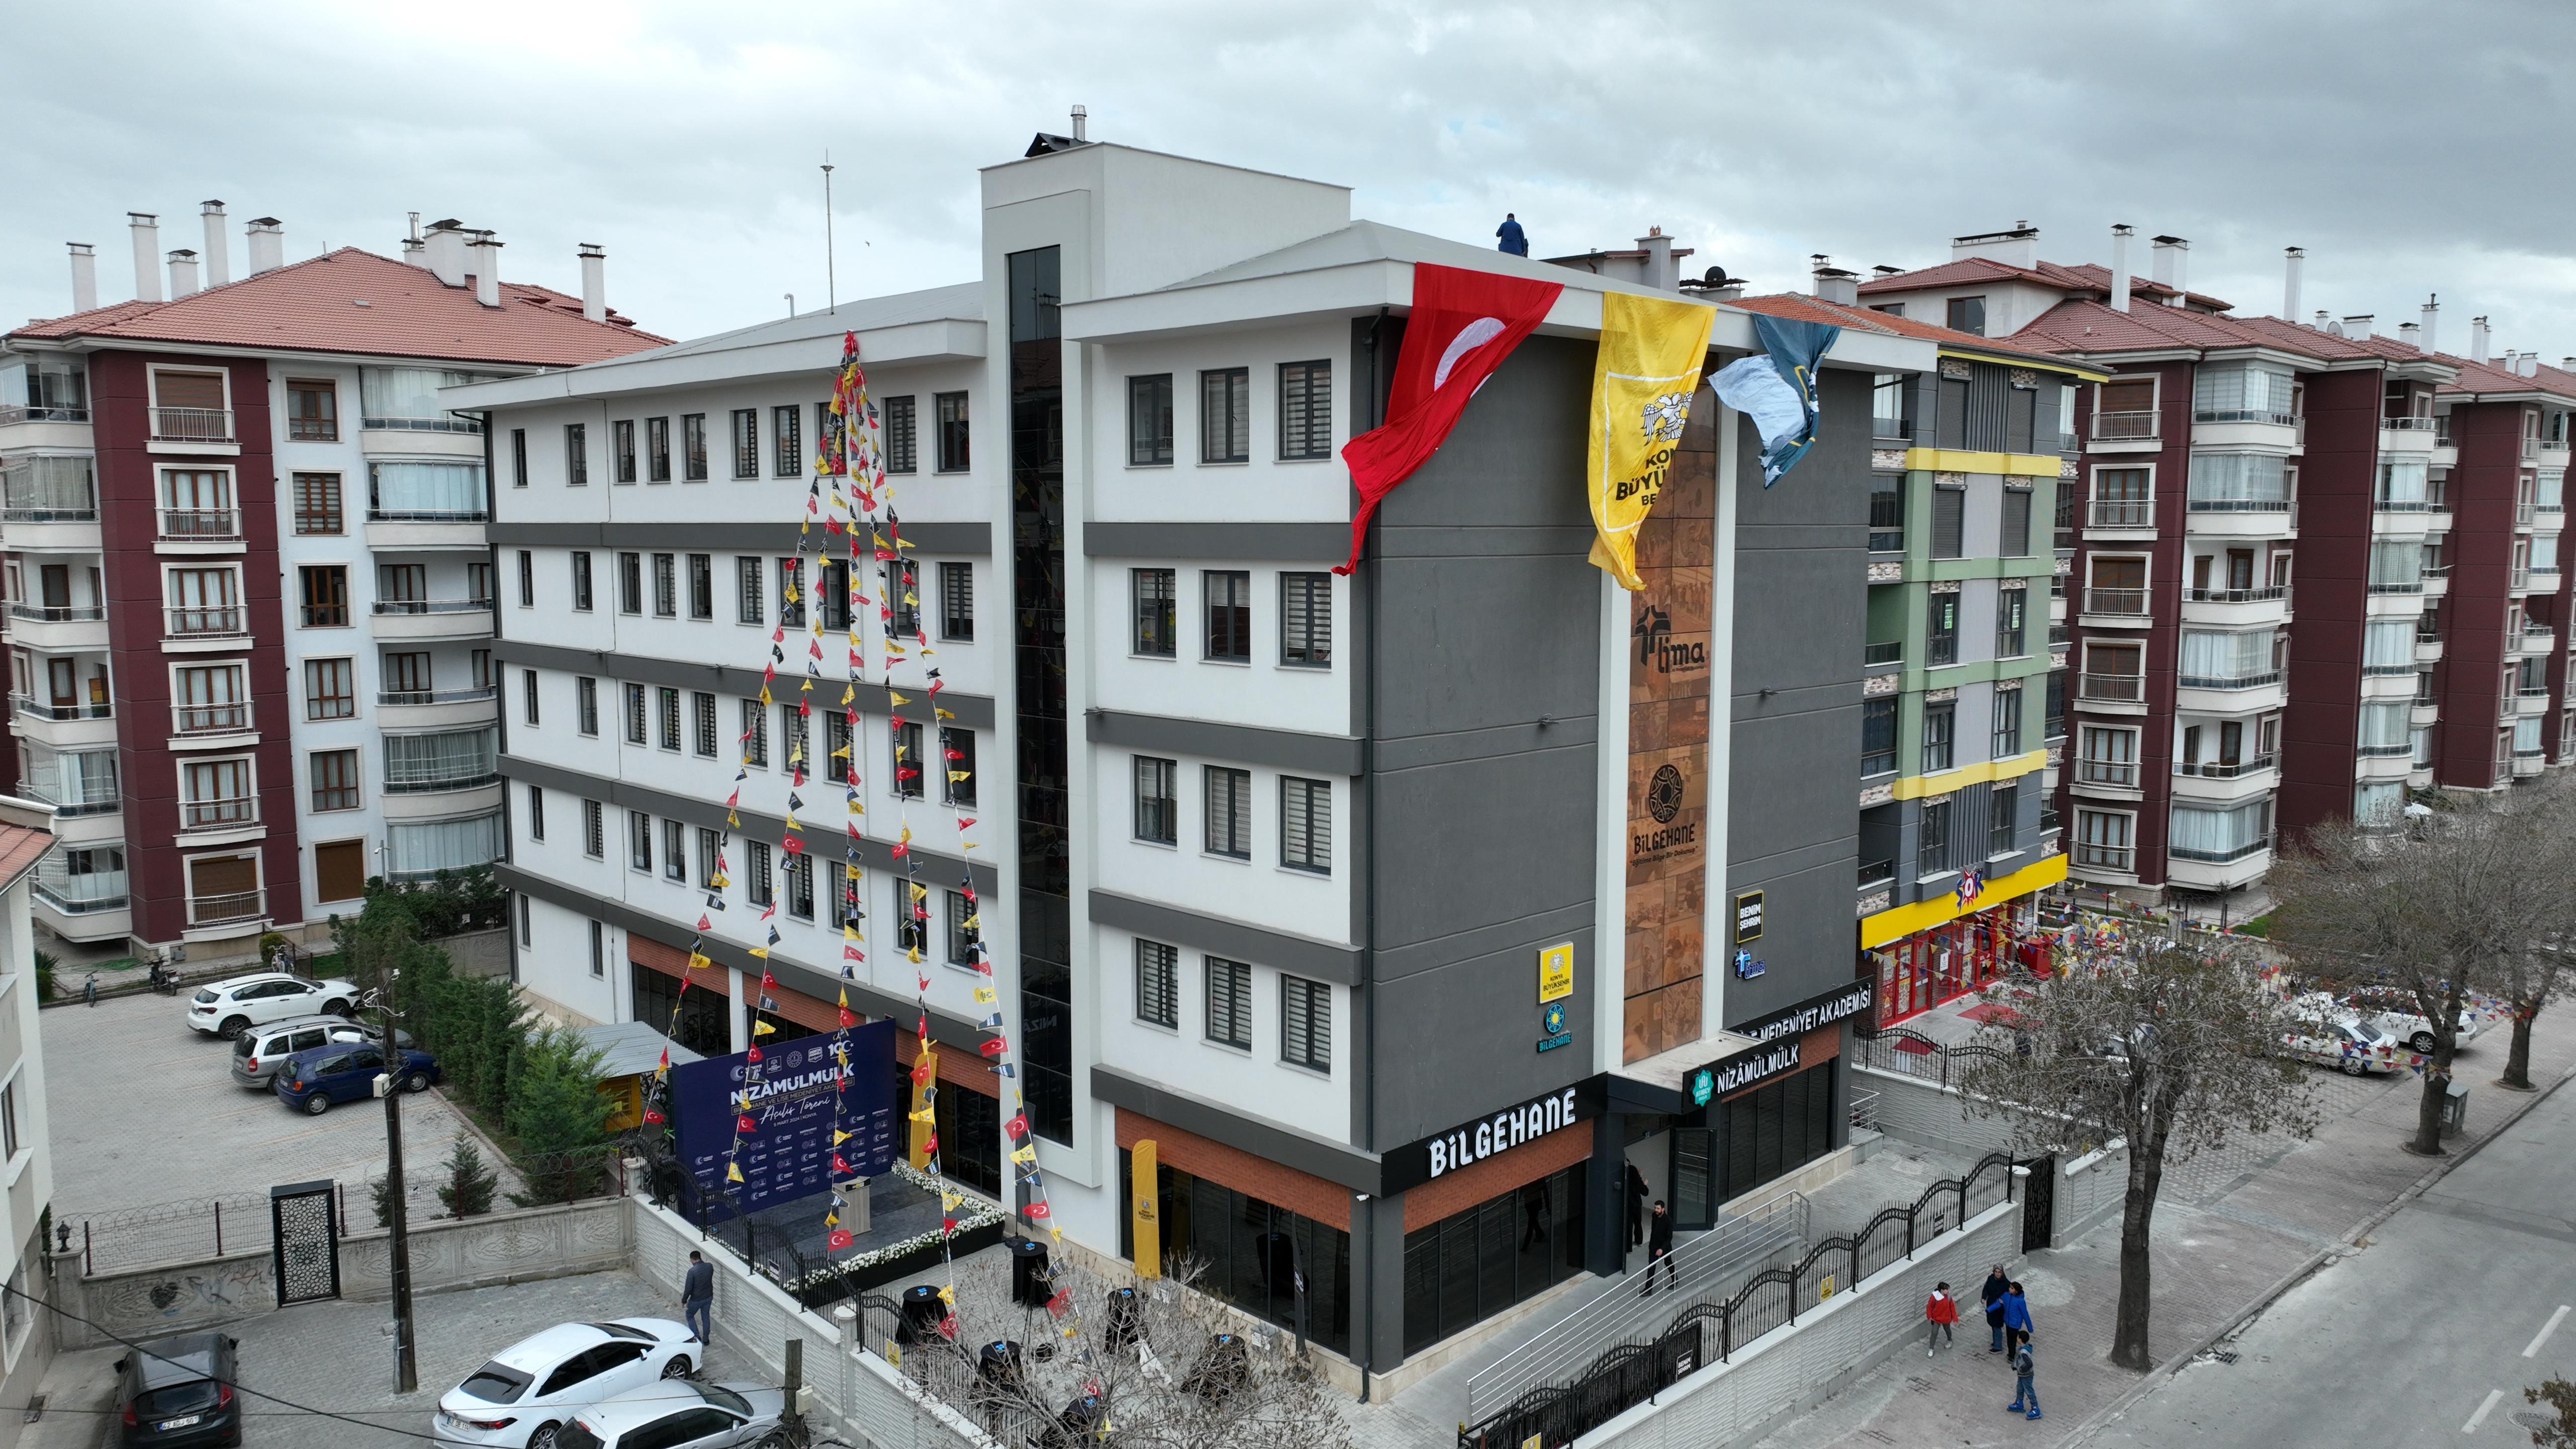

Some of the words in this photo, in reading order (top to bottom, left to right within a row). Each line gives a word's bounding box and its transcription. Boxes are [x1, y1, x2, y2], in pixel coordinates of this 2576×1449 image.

[1739, 915, 1761, 931] ŞEHRİM
[1740, 903, 1761, 919] BENİM
[1819, 985, 1871, 1025] AKADEMİSİ
[1429, 1088, 1576, 1178] BİLGEHANE
